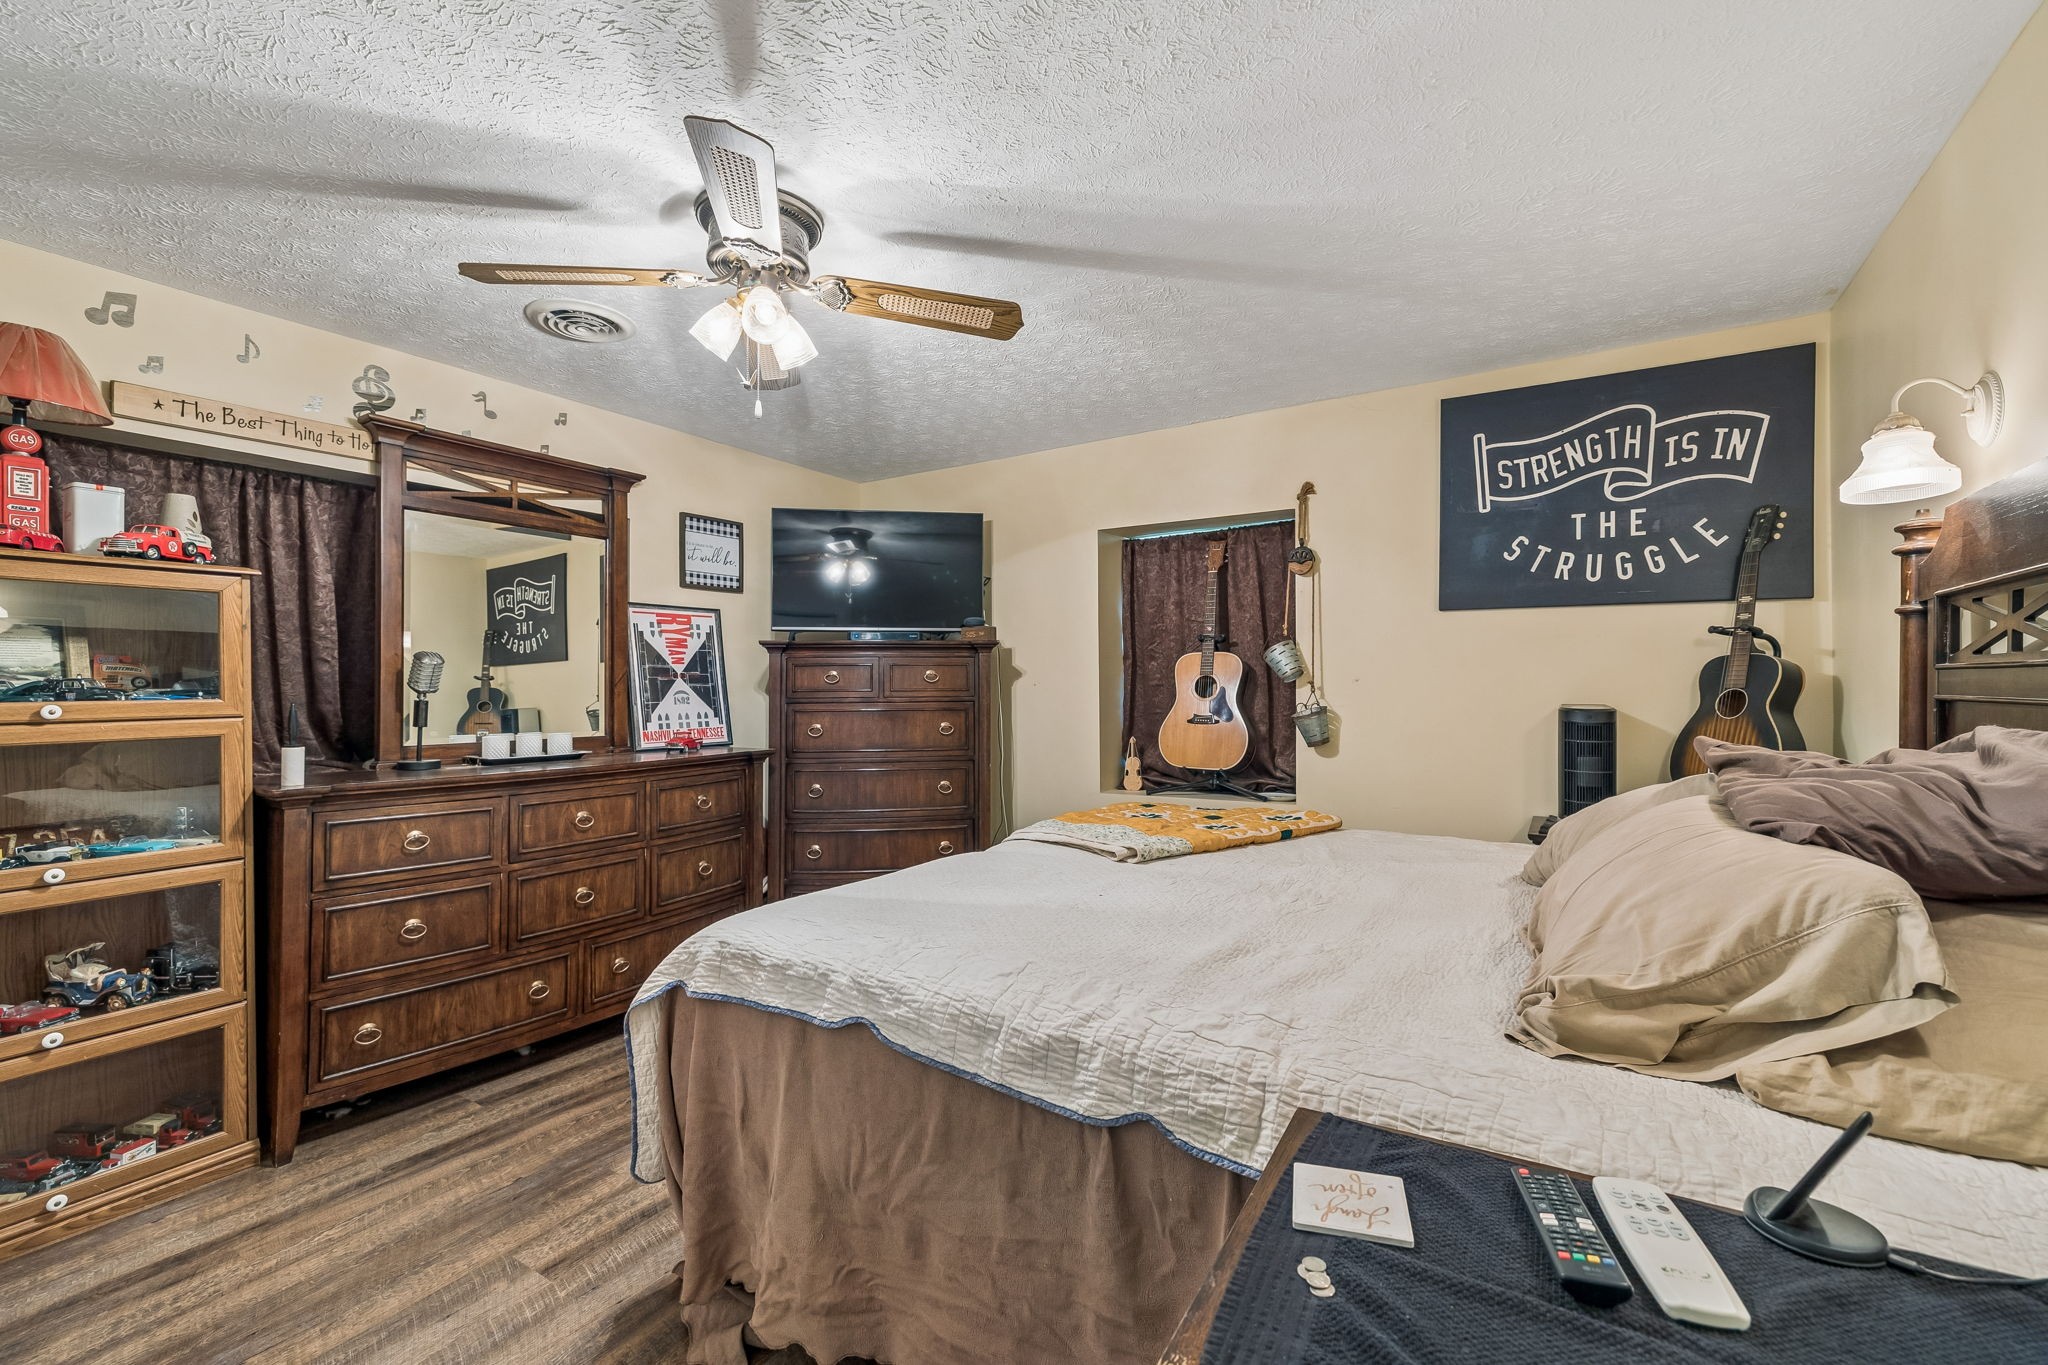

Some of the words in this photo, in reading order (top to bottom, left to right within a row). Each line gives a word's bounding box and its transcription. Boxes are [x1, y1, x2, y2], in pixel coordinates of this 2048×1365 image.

[9, 433, 35, 446] GAS
[171, 399, 216, 423] The
[222, 406, 273, 430] Best
[274, 419, 323, 447] Thing
[327, 429, 345, 446] to
[1497, 424, 1642, 490] STRENGTH
[1664, 430, 1700, 468] IS
[1710, 427, 1752, 461] IN
[12, 517, 37, 529] GAS
[1570, 507, 1648, 540] THE
[687, 546, 701, 561] it
[700, 546, 723, 564] will
[1502, 516, 1730, 583] STRUGGLE
[655, 613, 692, 665] RYMAN
